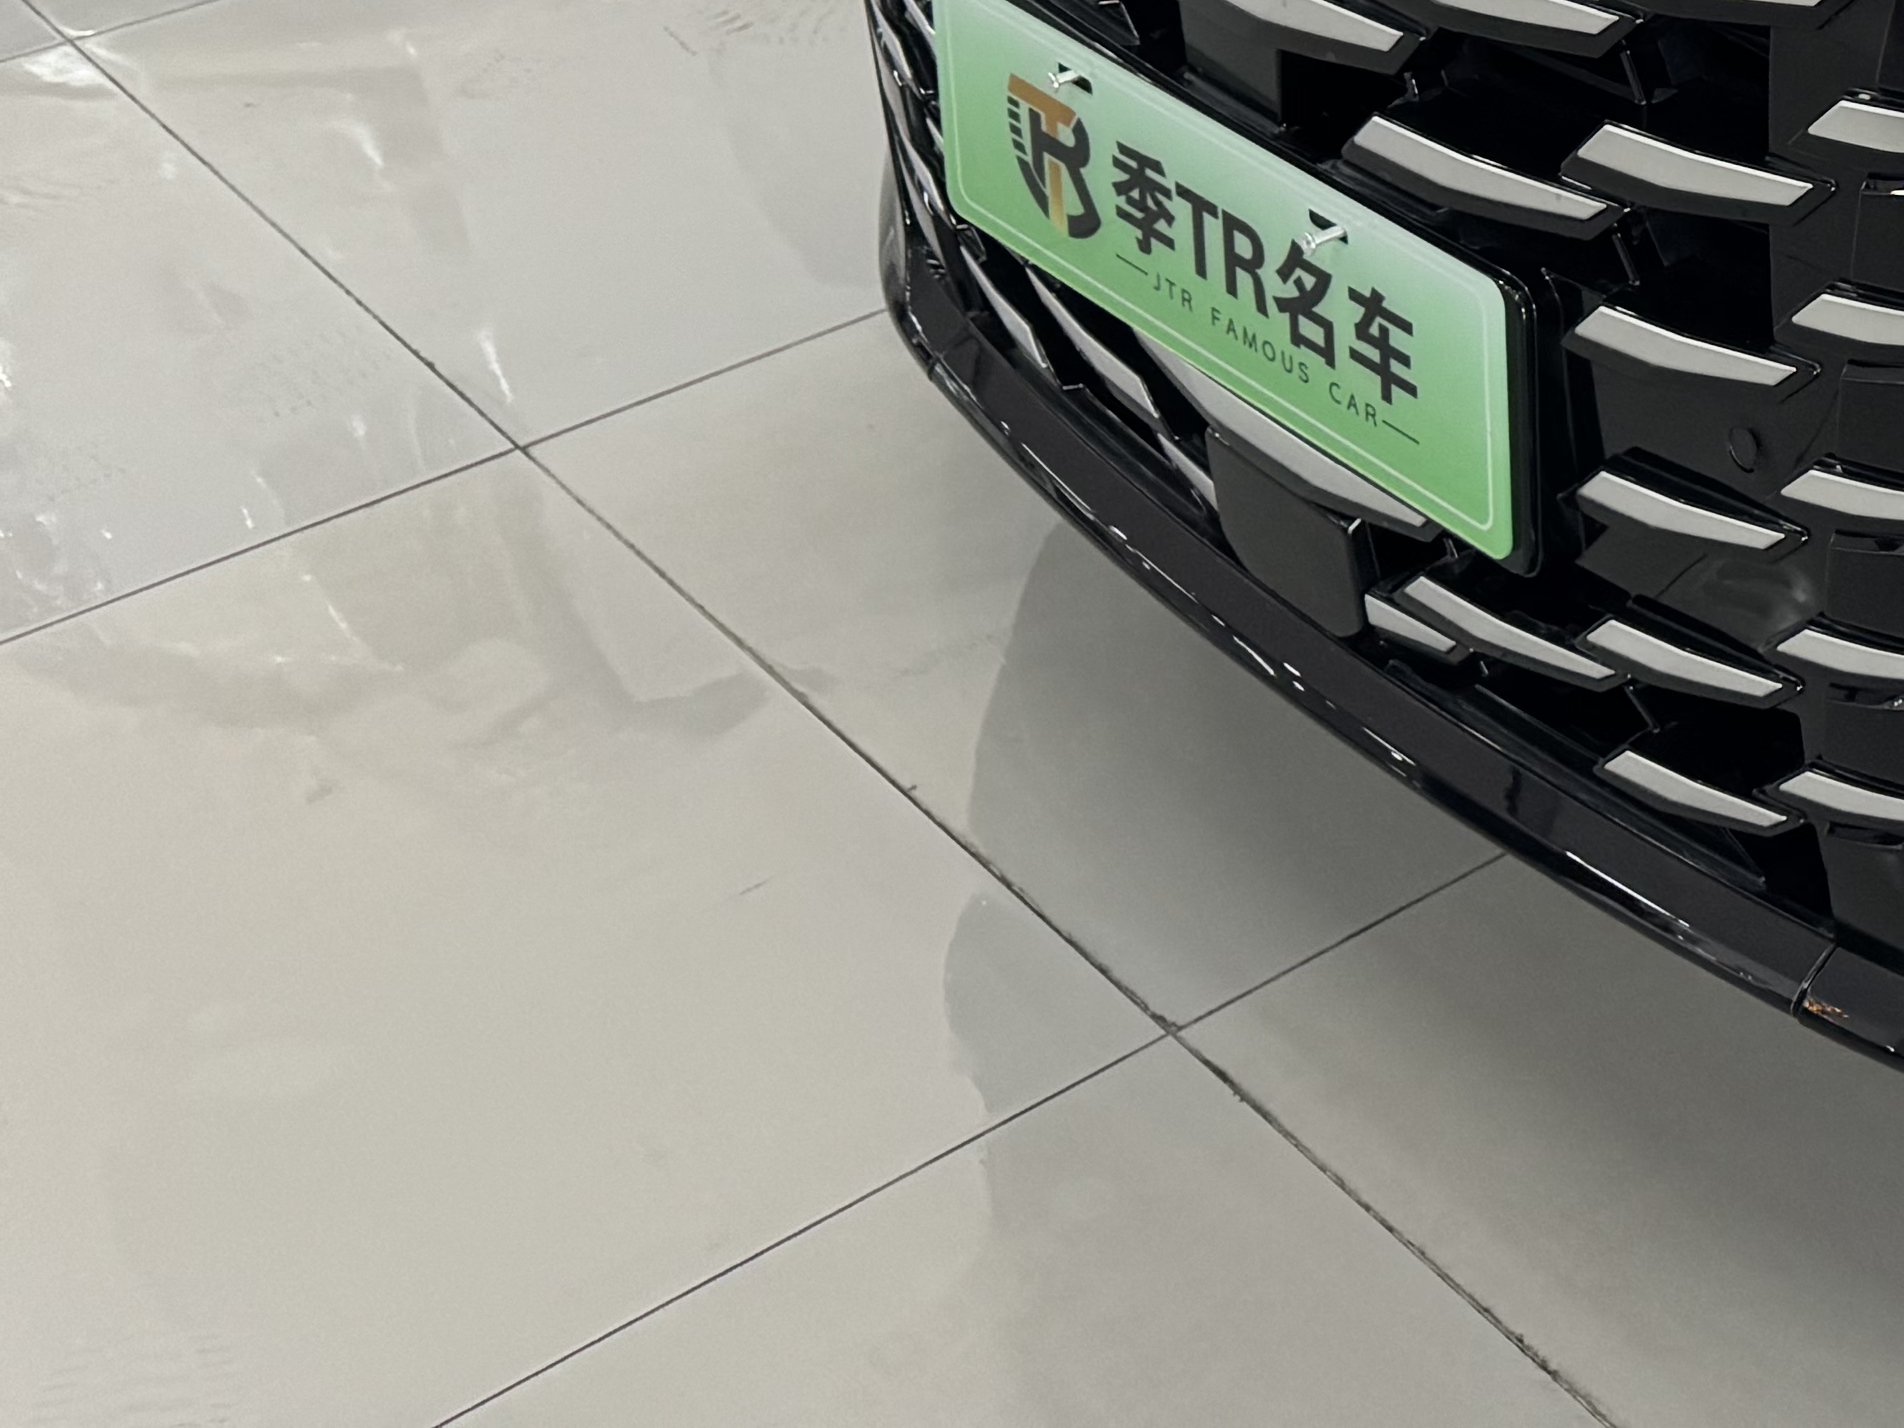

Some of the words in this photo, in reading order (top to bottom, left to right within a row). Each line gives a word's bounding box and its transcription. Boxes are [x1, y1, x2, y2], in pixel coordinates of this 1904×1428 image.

[1111, 140, 1419, 406] 季TR名车
[1153, 273, 1193, 313] JTR
[1210, 306, 1310, 384] FAMOUS
[1328, 382, 1378, 428] CAR
